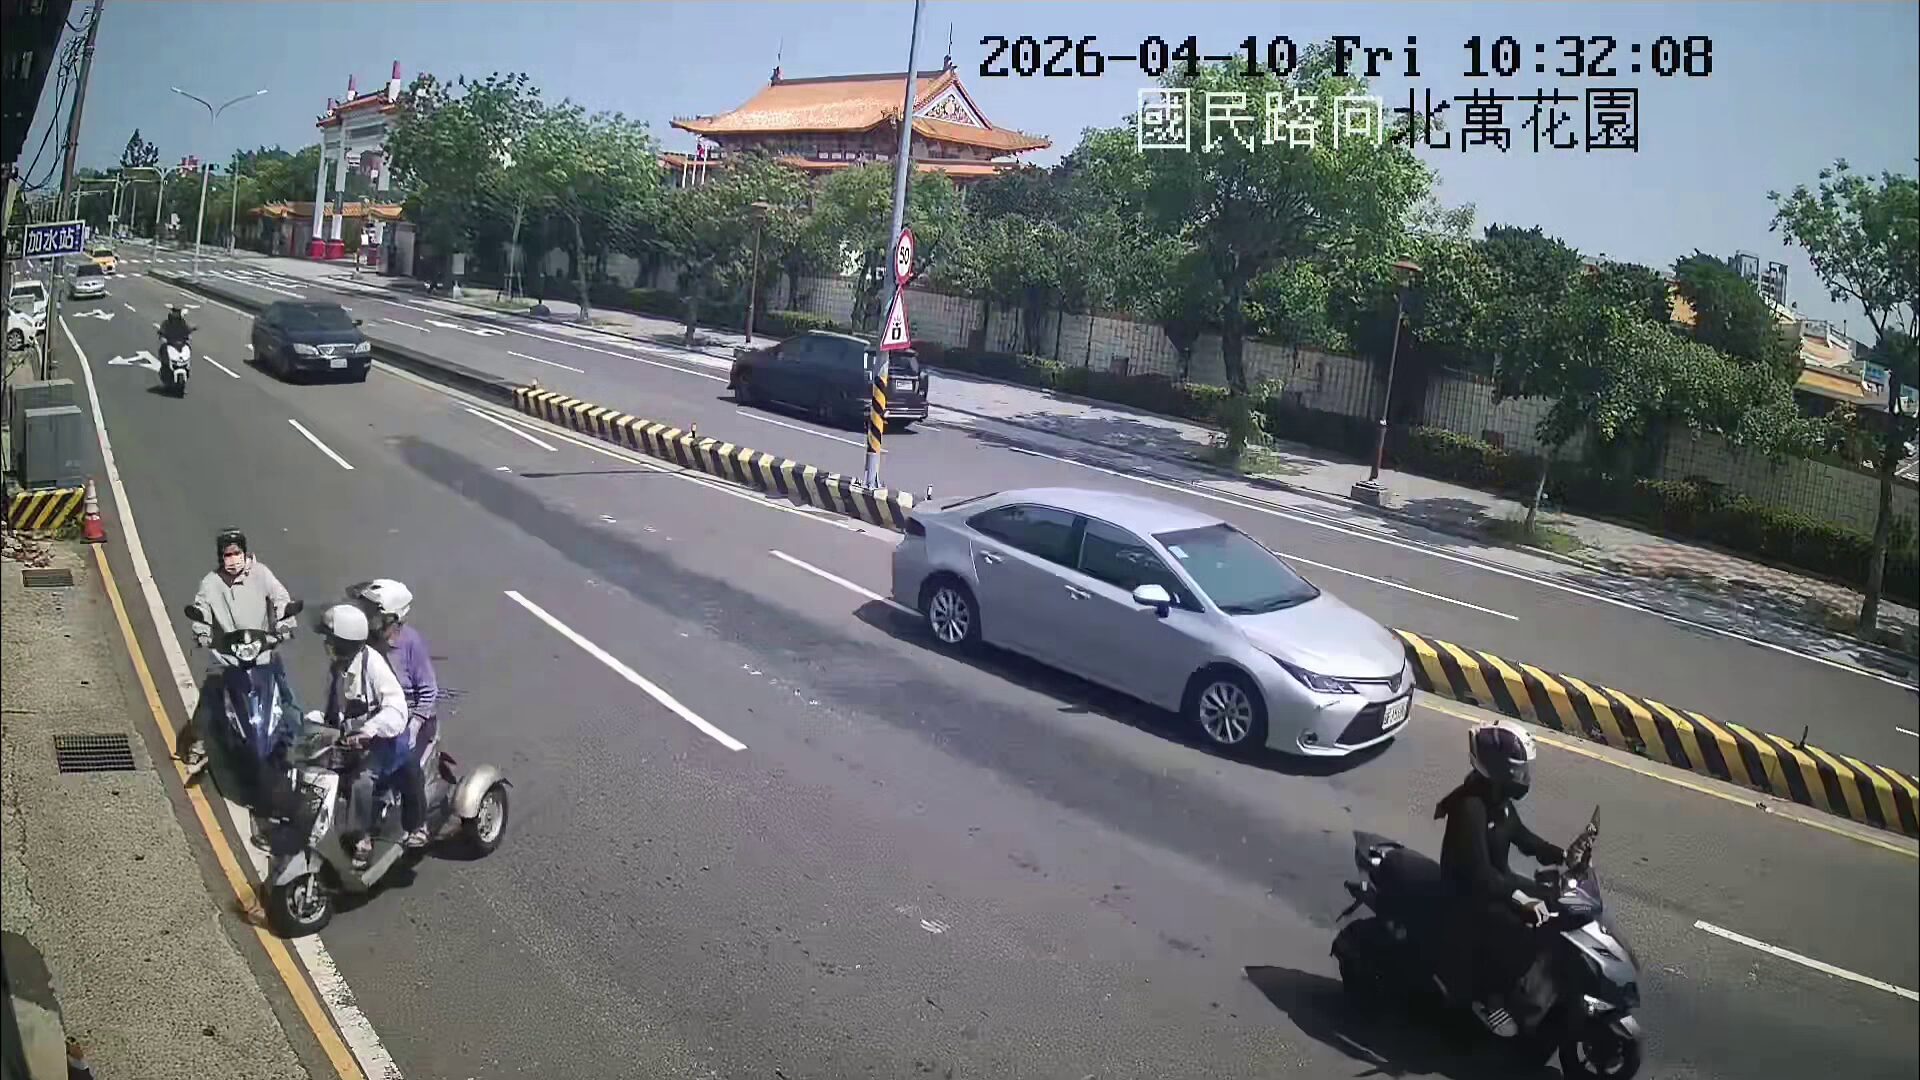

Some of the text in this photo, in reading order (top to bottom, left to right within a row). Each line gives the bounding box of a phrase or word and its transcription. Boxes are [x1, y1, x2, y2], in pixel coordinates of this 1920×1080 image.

[26, 227, 75, 253] 加水站
[898, 246, 910, 265] 50
